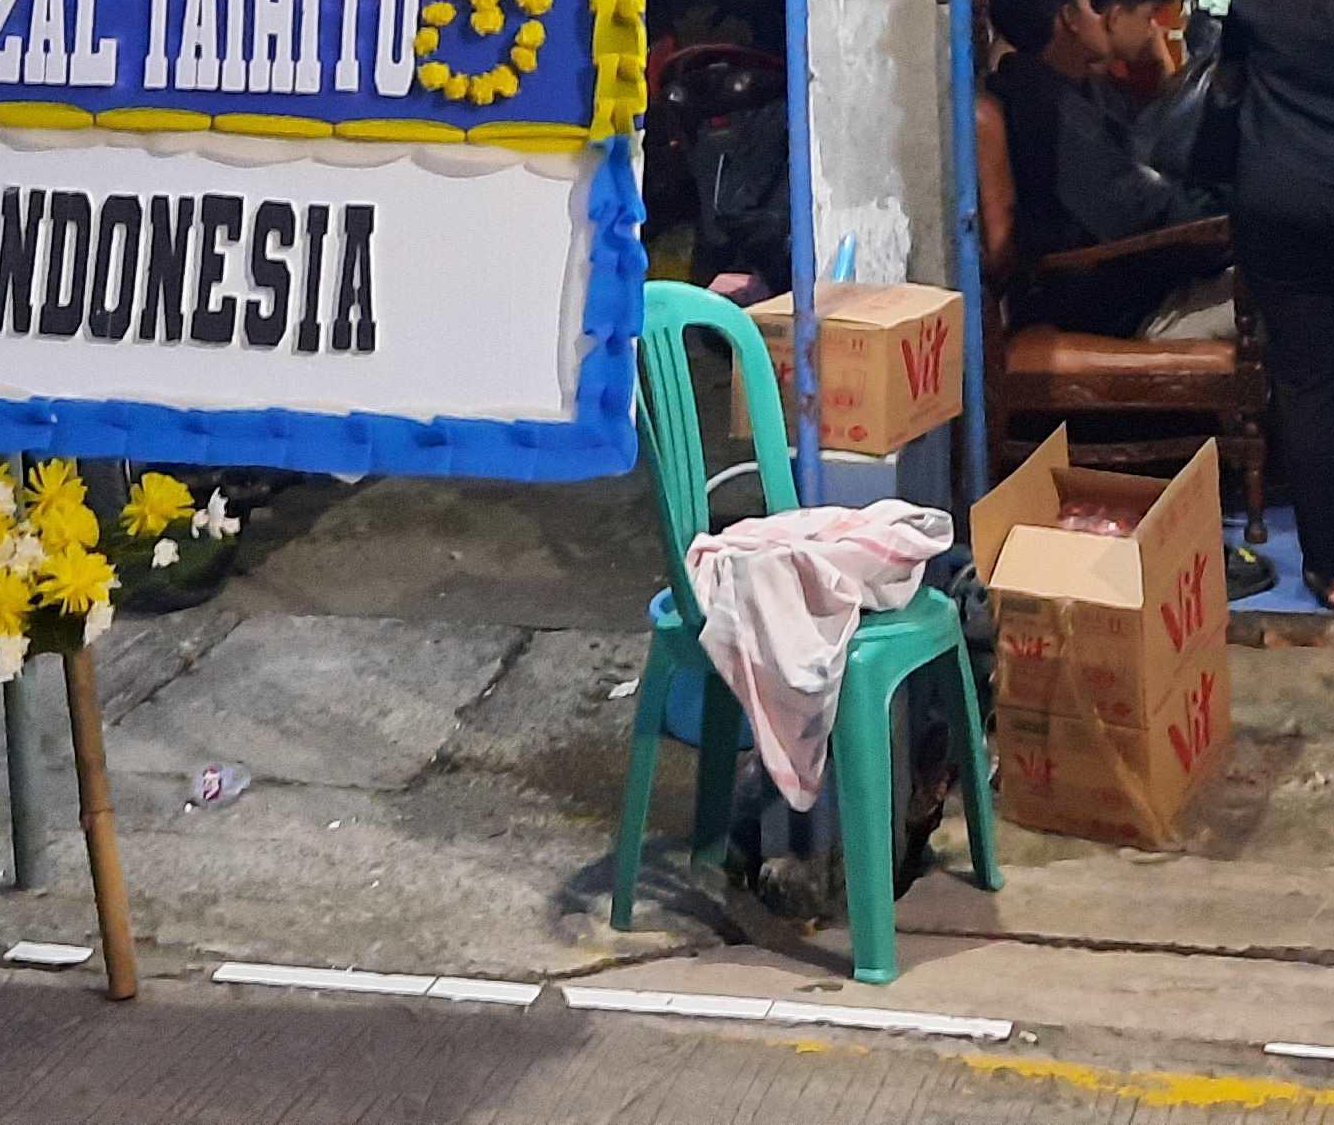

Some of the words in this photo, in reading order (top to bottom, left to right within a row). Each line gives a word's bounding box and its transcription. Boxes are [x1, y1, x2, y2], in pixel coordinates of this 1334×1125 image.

[901, 315, 949, 401] Vit
[1158, 551, 1211, 654] Vit
[1168, 671, 1215, 775] Vit
